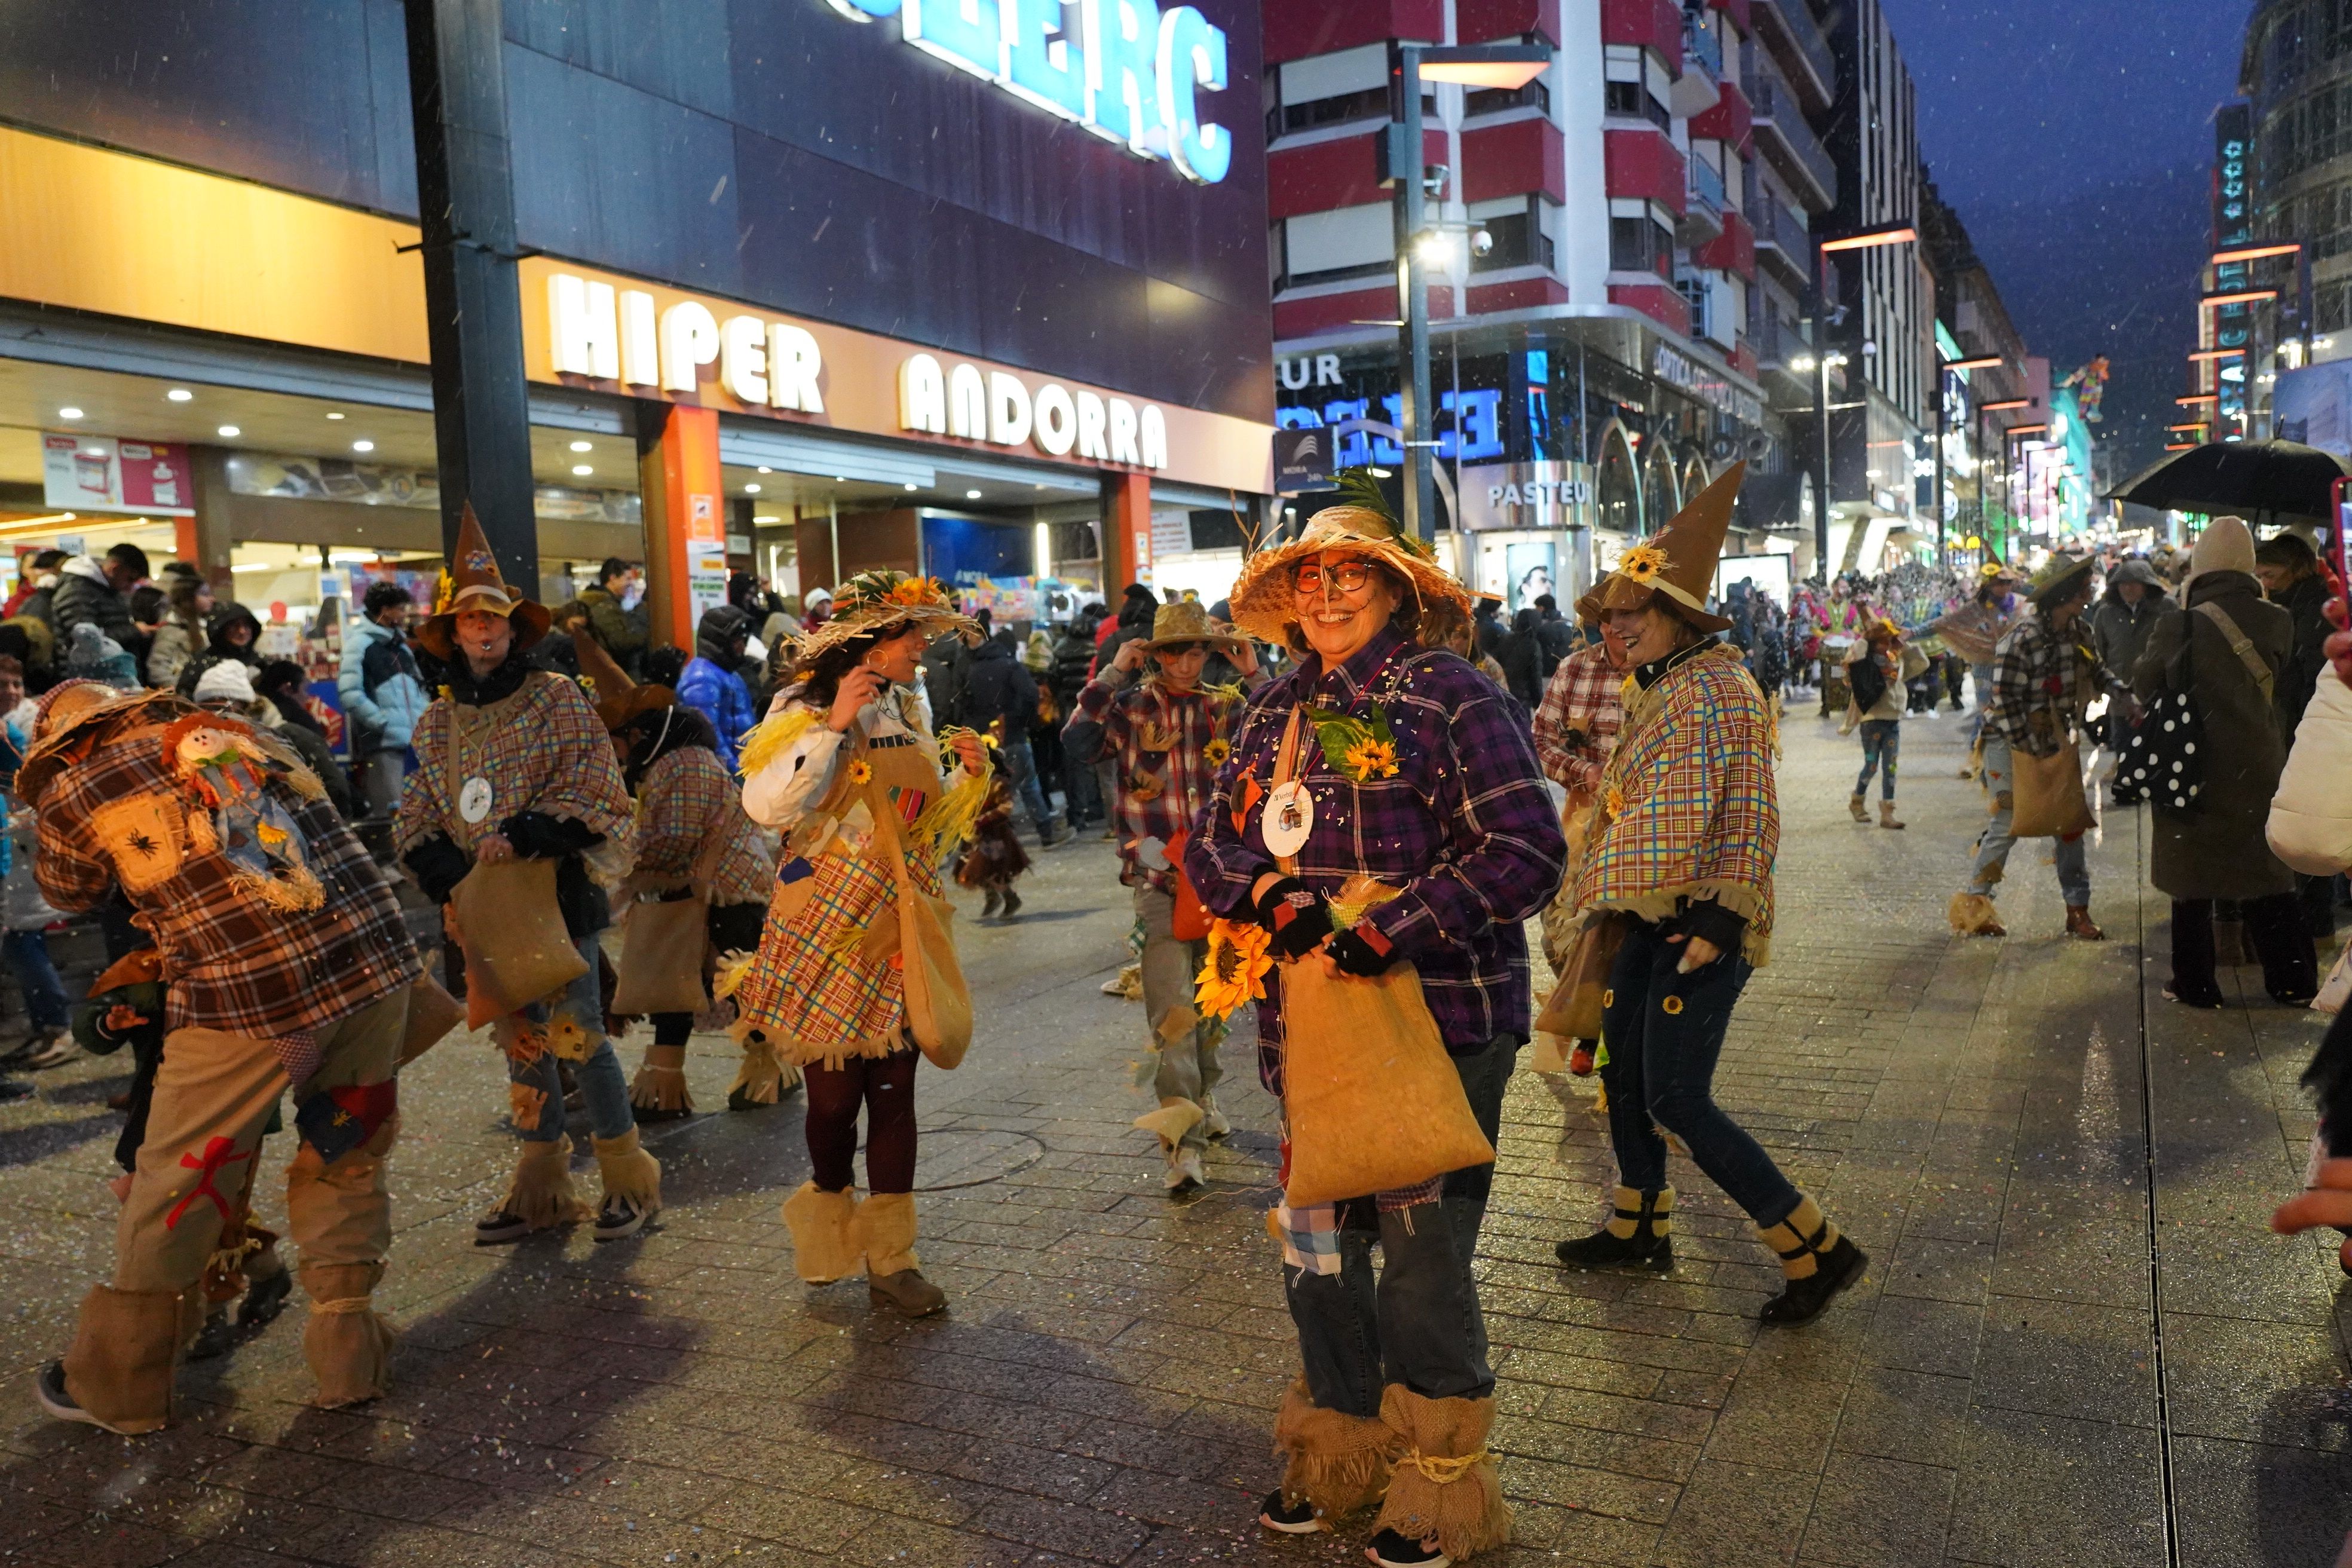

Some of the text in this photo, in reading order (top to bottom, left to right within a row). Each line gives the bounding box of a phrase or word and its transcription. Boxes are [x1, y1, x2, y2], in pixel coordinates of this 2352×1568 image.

[820, 0, 1232, 184] LERC
[547, 273, 1168, 470] HIPER ANDORRA
